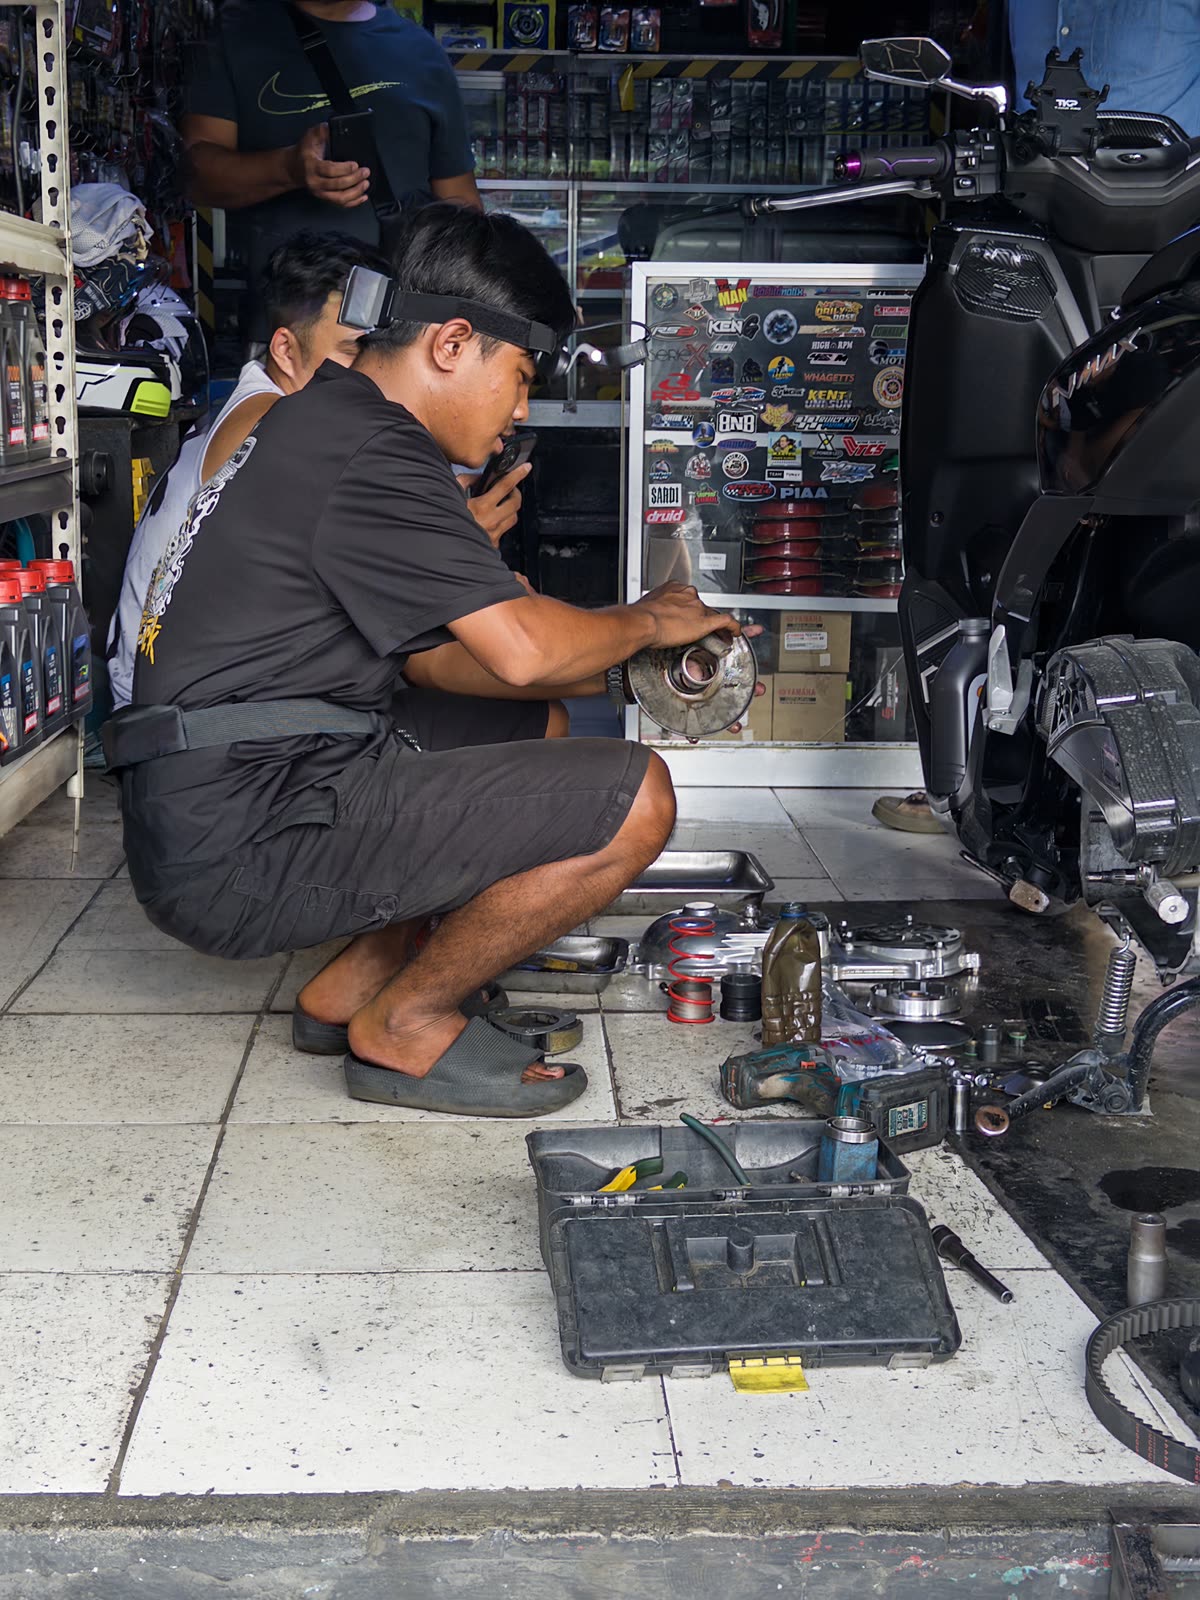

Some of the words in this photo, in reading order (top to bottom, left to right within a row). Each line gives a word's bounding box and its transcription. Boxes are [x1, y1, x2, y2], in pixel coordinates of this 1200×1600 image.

[717, 287, 748, 307] MAN
[811, 341, 830, 350] HIGH
[837, 341, 854, 350] RPM
[803, 373, 856, 383] WHAGETTS
[651, 390, 701, 401] RCB
[807, 389, 847, 401] KENT
[651, 487, 679, 504] SARDI
[780, 486, 829, 499] PIAA
[646, 509, 683, 523] druid
